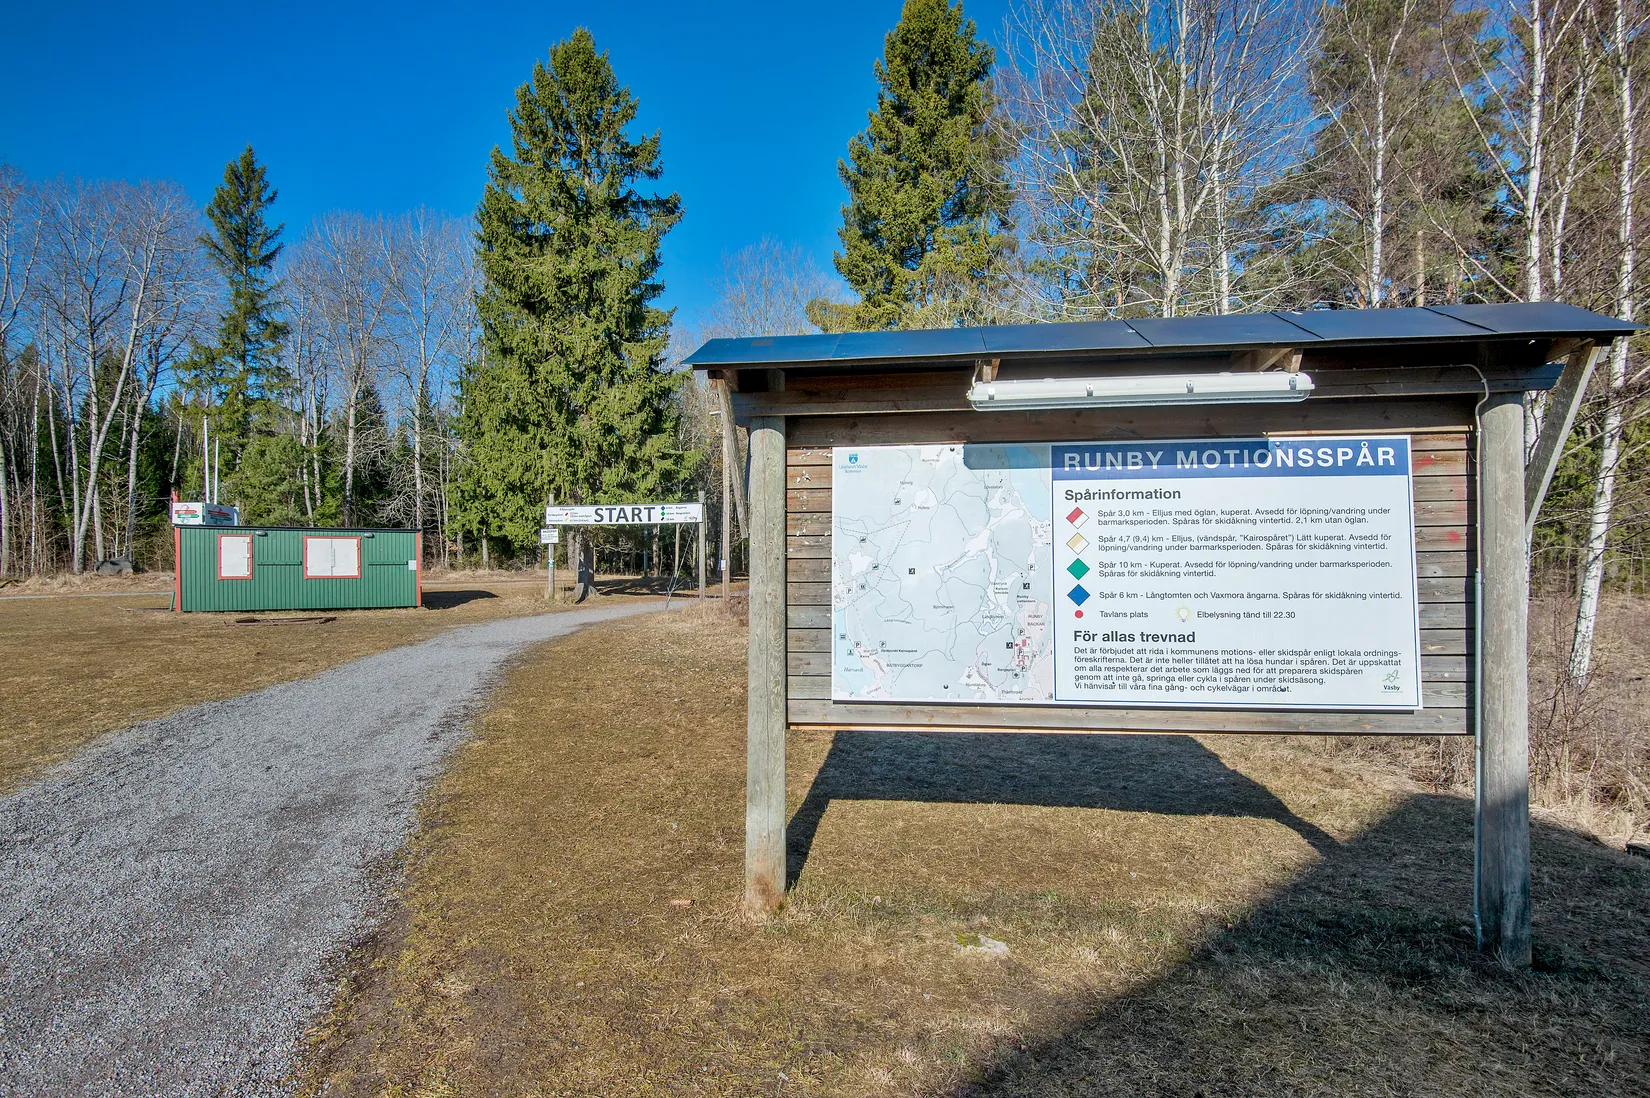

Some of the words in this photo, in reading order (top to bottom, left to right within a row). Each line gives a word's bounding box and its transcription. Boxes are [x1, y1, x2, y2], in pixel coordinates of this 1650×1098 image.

[1065, 451, 1164, 471] RUNBY
[1178, 441, 1395, 469] MOTIONSSPÅR
[1064, 488, 1181, 502] Spårinformation
[594, 507, 655, 523] START
[1098, 509, 1116, 518] Spår
[1175, 509, 1192, 518] med
[1255, 508, 1284, 517] Avsedd
[1300, 507, 1365, 516] löpning/vandring
[1172, 517, 1200, 526] Spåras
[1215, 517, 1257, 525] skidåkning
[1098, 535, 1116, 543] Spår
[1297, 534, 1312, 543] Lätt
[1098, 544, 1162, 552] löpning/vandring
[1266, 543, 1293, 551] Spåras
[1309, 542, 1351, 551] skidåkning
[1098, 561, 1117, 569] Spår
[1228, 560, 1293, 569] löpning/vandring
[1099, 569, 1125, 578] Spåras
[1140, 569, 1181, 578] skidåkning
[1099, 591, 1117, 599] Spår
[1146, 591, 1191, 600] Långtomten
[1283, 591, 1310, 600] Spåras
[1325, 591, 1366, 600] skidåkning
[1130, 611, 1148, 619] plats
[1197, 610, 1241, 620] Elbelysning
[1074, 630, 1098, 641] För
[1102, 630, 1135, 642] allas
[1139, 631, 1195, 642] trevnad
[1074, 646, 1087, 656] Det
[1090, 647, 1097, 656] är
[1099, 647, 1134, 656] förbjudet
[1170, 648, 1219, 657] kommunens
[1278, 648, 1311, 657] skidspår
[1314, 649, 1335, 658] enligt
[1363, 649, 1401, 658] ordnings-
[1358, 658, 1401, 667] uppskattat
[1104, 665, 1148, 674] respekterar
[1212, 666, 1233, 675] läggs
[1236, 666, 1250, 675] ned
[1319, 667, 1363, 676] skidspåren
[1074, 674, 1101, 682] genom
[1103, 674, 1114, 683] att
[1116, 674, 1130, 683] inte
[1146, 674, 1175, 684] springa
[1196, 675, 1217, 683] cykla
[1224, 675, 1251, 683] spåren
[1253, 676, 1276, 685] under
[1165, 682, 1187, 692] gång-
[1207, 684, 1250, 693] cykelvägar
